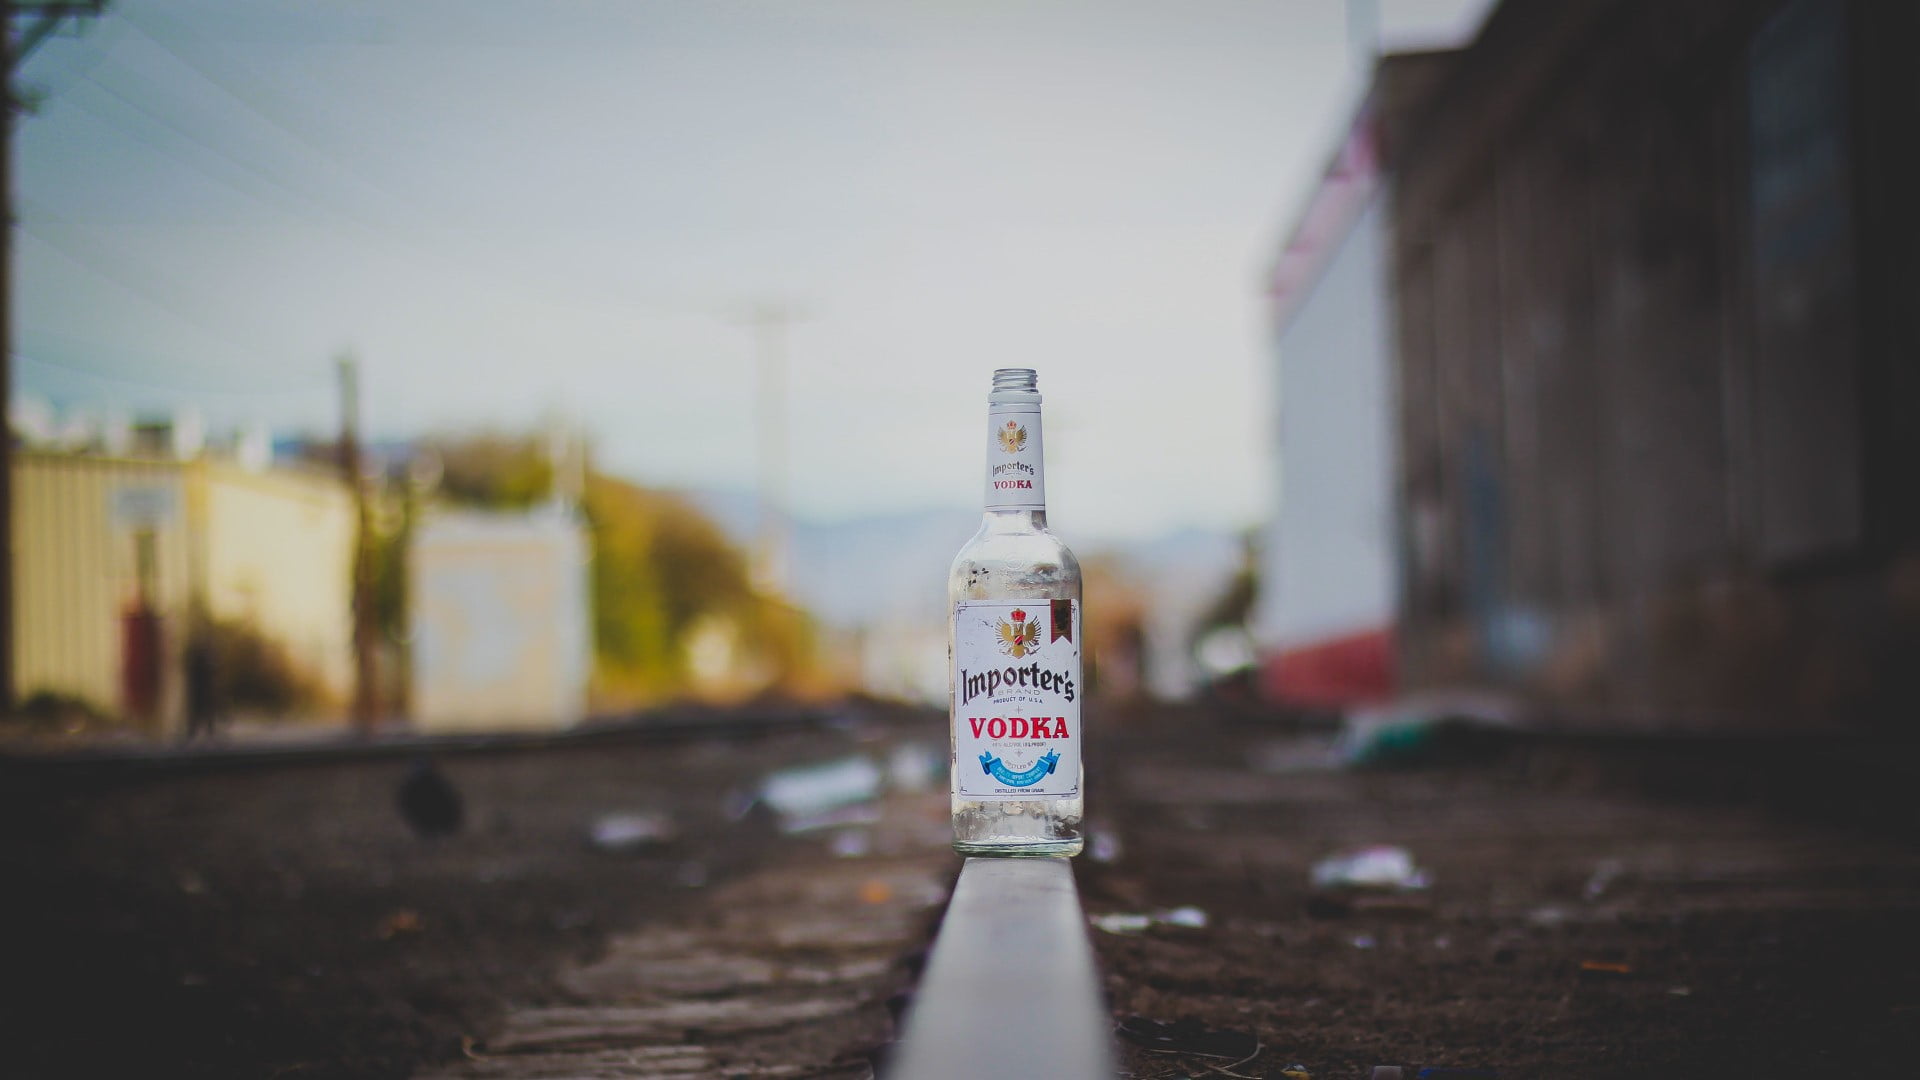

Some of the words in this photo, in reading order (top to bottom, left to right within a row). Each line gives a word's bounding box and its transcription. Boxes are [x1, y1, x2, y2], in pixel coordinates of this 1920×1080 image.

[993, 461, 1035, 477] Importer's
[994, 480, 1032, 489] VODKA
[961, 661, 1075, 706] Importer's
[998, 688, 1041, 696] BRAND
[993, 696, 1016, 704] PRODUCT
[968, 717, 1070, 739] VODKA
